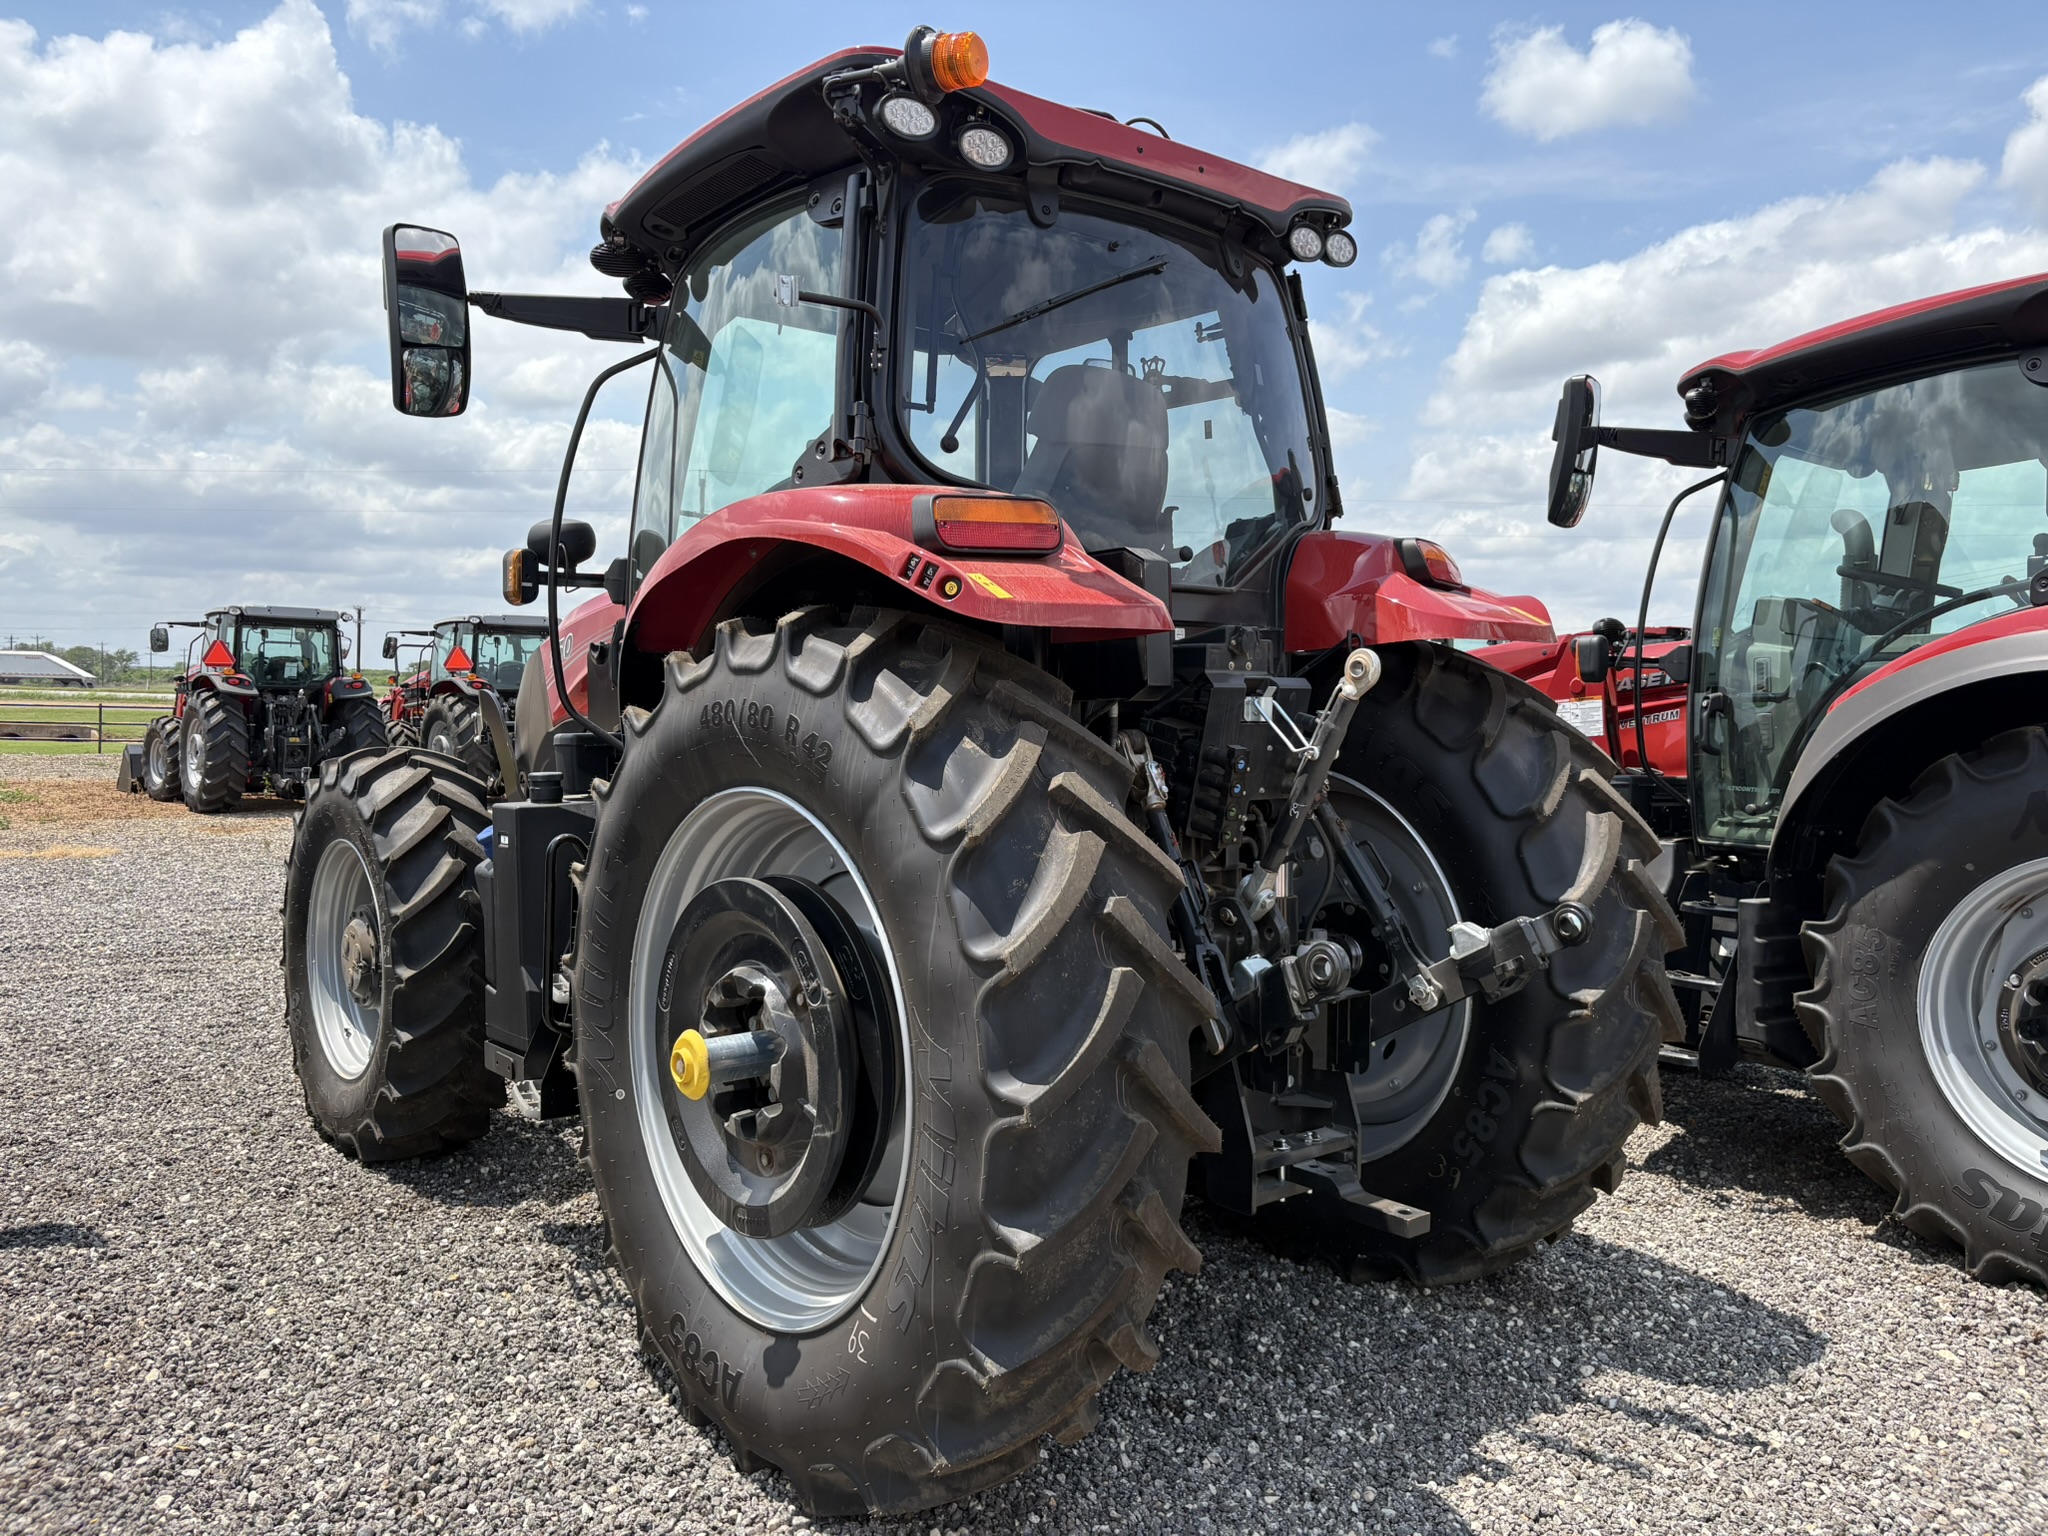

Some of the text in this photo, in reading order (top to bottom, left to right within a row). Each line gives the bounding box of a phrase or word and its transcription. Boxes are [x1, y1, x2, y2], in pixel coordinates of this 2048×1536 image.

[1616, 671, 1664, 692] ASE
[1620, 709, 1680, 730] VETRUM
[700, 698, 833, 776] 480/80 R 42
[1848, 928, 1886, 1031] AC85
[1452, 1046, 1519, 1167] AC85
[1428, 1153, 1461, 1190] 39
[660, 1312, 744, 1413] AC85
